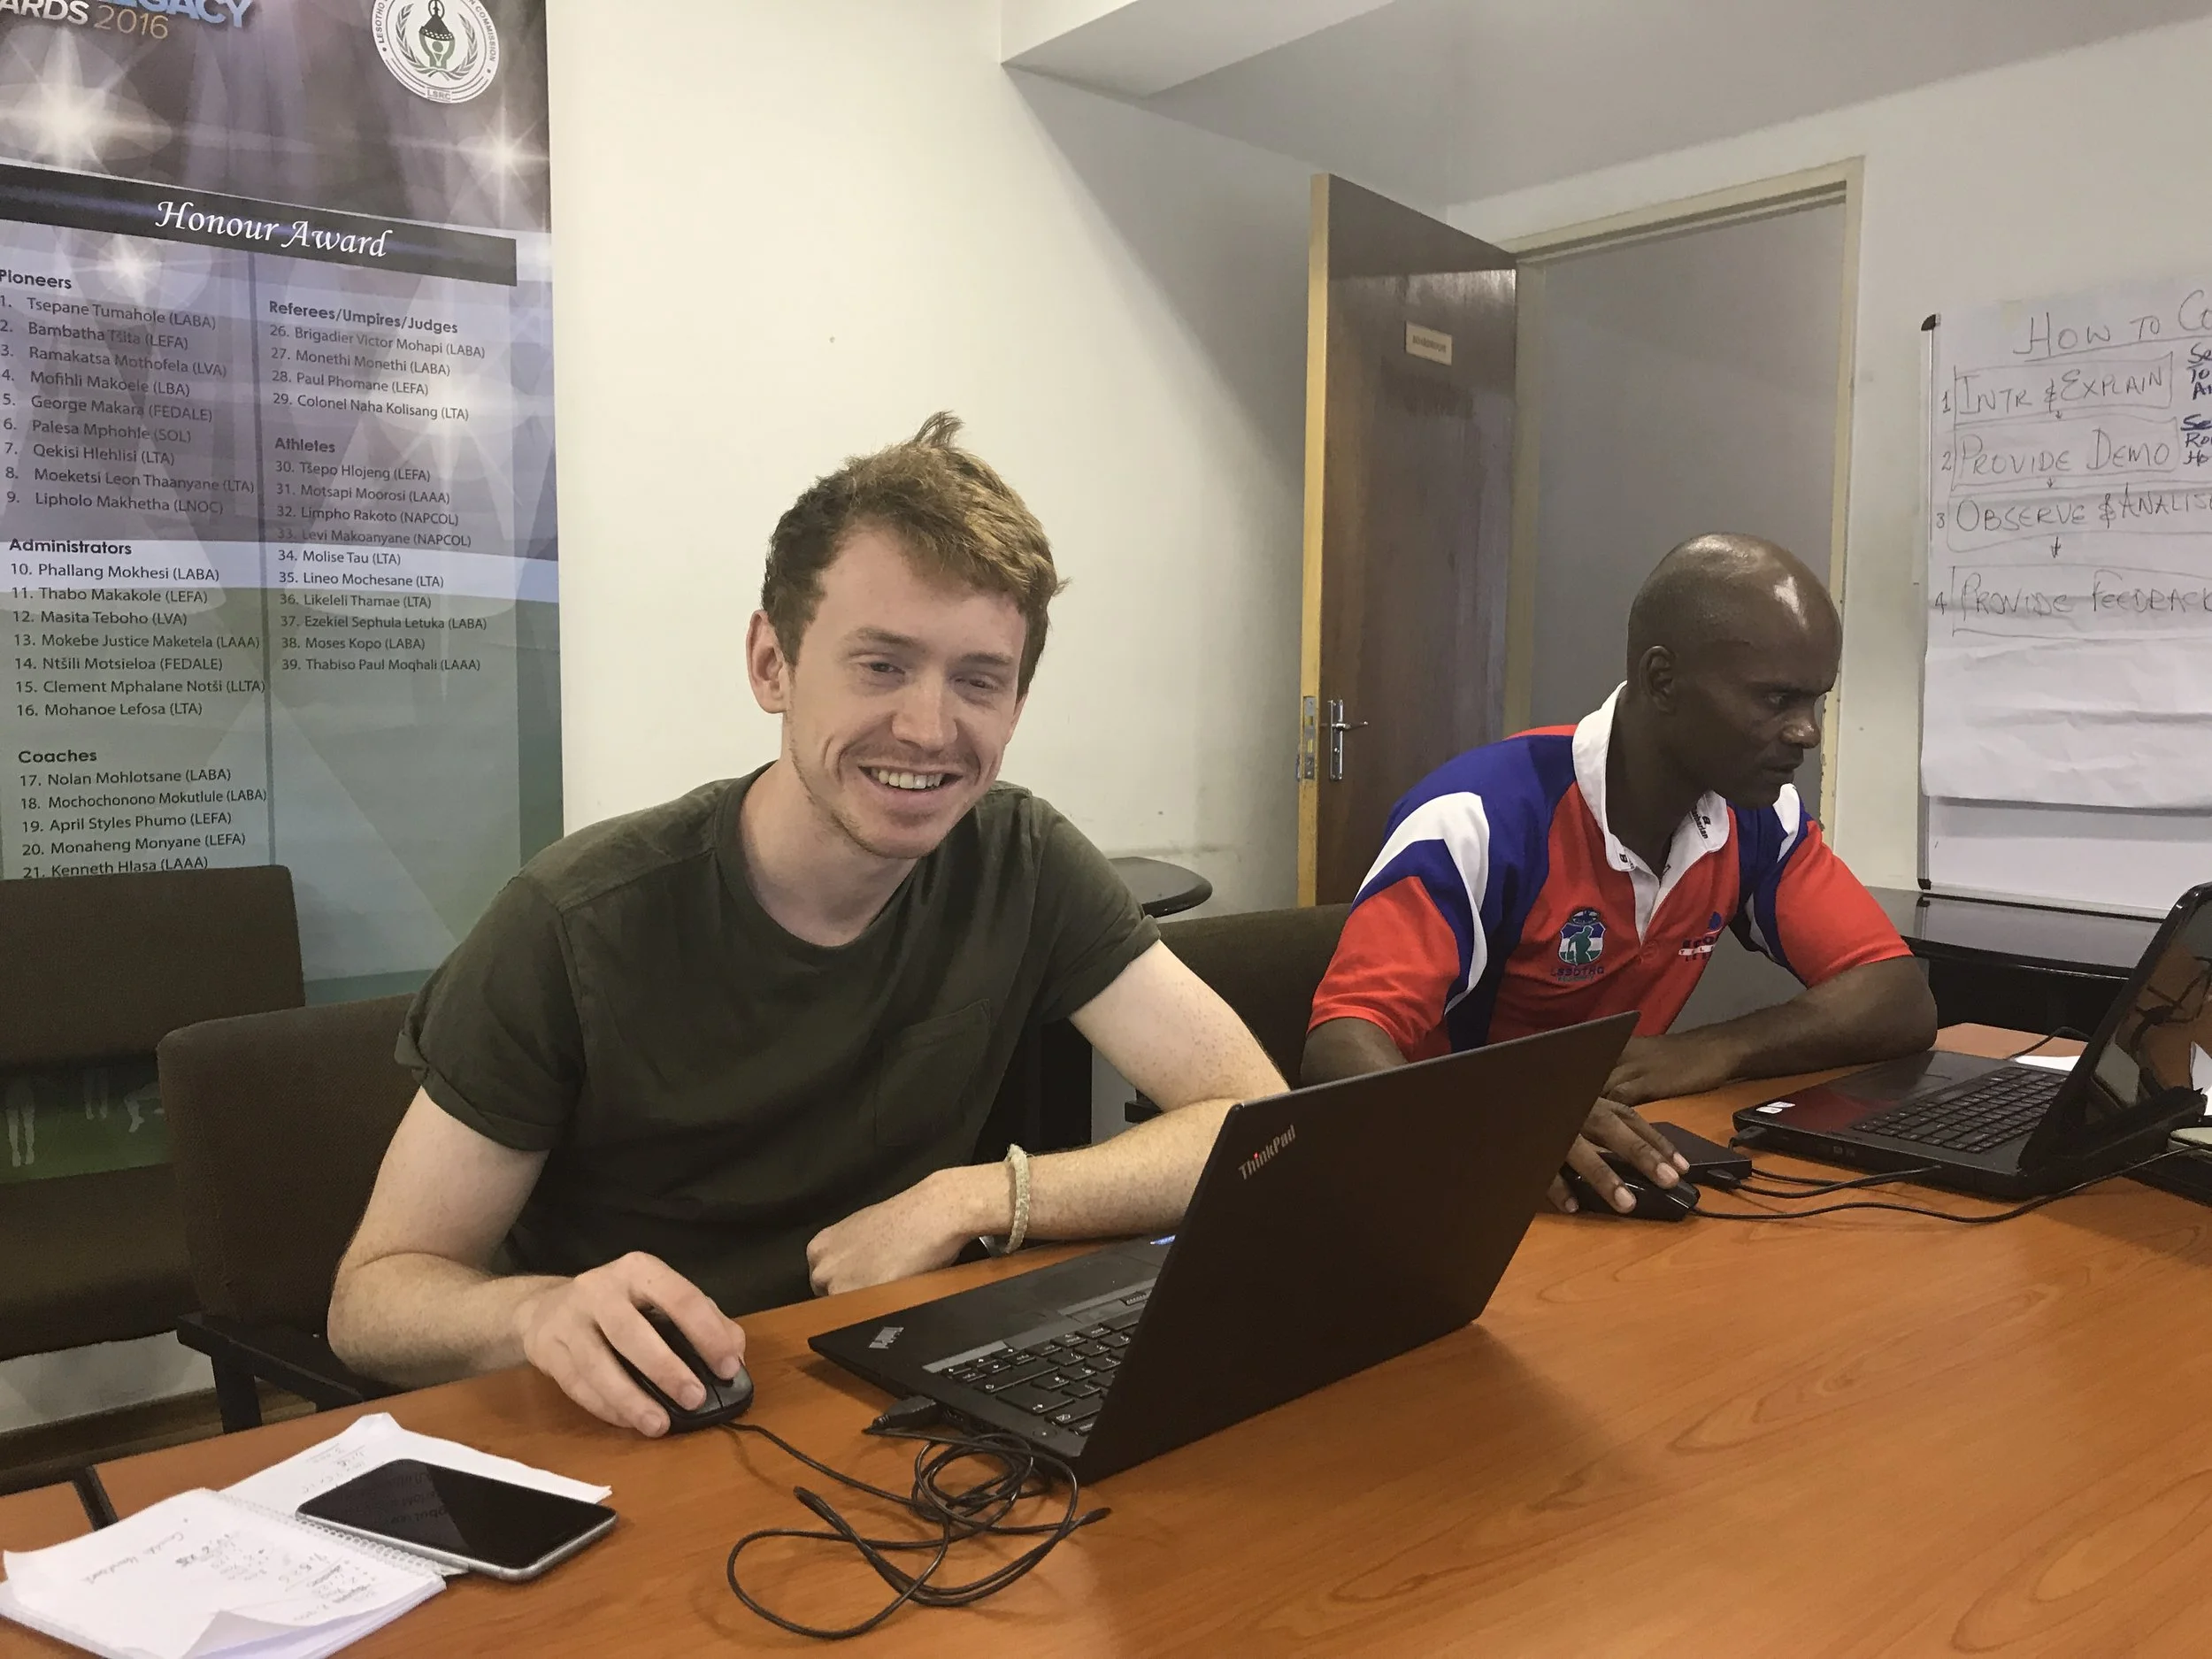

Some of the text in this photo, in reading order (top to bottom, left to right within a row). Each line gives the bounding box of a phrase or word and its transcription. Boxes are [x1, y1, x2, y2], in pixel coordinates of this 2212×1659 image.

[93, 4, 168, 40] 2016
[375, 3, 385, 43] LESOTHO
[475, 5, 496, 62] COMMISSION
[155, 200, 394, 257] Honour Award
[27, 297, 216, 330] Tsepane Tumahole (LABA)
[269, 301, 458, 334] Referees/Umpires/Judges
[28, 322, 104, 342] Bambatha
[145, 334, 188, 349] (LEFA)
[2130, 316, 2161, 341] TO
[296, 327, 486, 358] Brigadier Victor Mohapi (LABA)
[29, 347, 110, 365] Ramakatsa
[192, 362, 226, 378] (LVA)
[296, 350, 450, 376] Monethi Monethi (LABA)
[87, 378, 149, 393] Makoele
[153, 381, 190, 396] (LBA)
[297, 373, 428, 396] Paul Phomane (LEFA)
[32, 396, 212, 422] George Makara (FEDALE)
[273, 393, 469, 421] 29. Colonel Naha Kolisang (LTA)
[33, 419, 191, 443] Palesa Mphohle (SOL)
[34, 444, 173, 465] Qekisi Hlehlisi (LTA)
[275, 437, 335, 453] Athletes
[35, 468, 254, 493] Moeketsi Leon Thaanyane (LTA)
[342, 465, 390, 480] Hlojeng
[394, 468, 430, 482] (LEFA)
[35, 493, 223, 514] Lipholo Makhetha (LNOC)
[300, 484, 450, 504] Motsapi Moorosi (LAAA)
[302, 507, 458, 526] Limpho Rakoto (NAPCOL)
[10, 539, 132, 555] Administrators
[303, 529, 471, 548] Levi Makoanyane (NAPCOL)
[303, 549, 401, 565] Molise Tau (LTA)
[12, 564, 219, 581] 10. Phallang Mokhesi (LABA)
[279, 572, 443, 588] 35. Lineo Mochesane (LTA)
[39, 588, 207, 604] Thabo Makakole (LEFA)
[304, 594, 432, 609] Likeleli Thamae (LTA)
[41, 611, 187, 626] Masita Teboho (LVA)
[304, 616, 487, 631] Ezekiel Sephula Letuka (LABA)
[42, 634, 260, 649] Mokebe Justice Maketela (LAAA)
[306, 638, 425, 651] Moses Kopo (LABA)
[85, 657, 156, 670] Motsieloa
[160, 657, 222, 672] (FEDALE)
[306, 658, 480, 672] Thabiso Paul Moqhali (LAAA)
[43, 680, 106, 693] Clement
[111, 680, 182, 695] Mphalane
[227, 680, 265, 694] (LLTA)
[44, 703, 203, 716] Mohanoe Lefosa (LTA)
[19, 750, 97, 763] Coaches
[19, 769, 231, 786] 17. Nolan Mohlotsane (LABA)
[49, 789, 266, 809] Mochochonono Mokutlule (LABA)
[50, 812, 232, 833] April Styles Phumo (LEFA)
[51, 833, 246, 855] Monaheng Monyane (LEFA)
[51, 856, 208, 876] Kenneth Hlasa (LAAA)
[1239, 1125, 1295, 1179] ThinkPad
